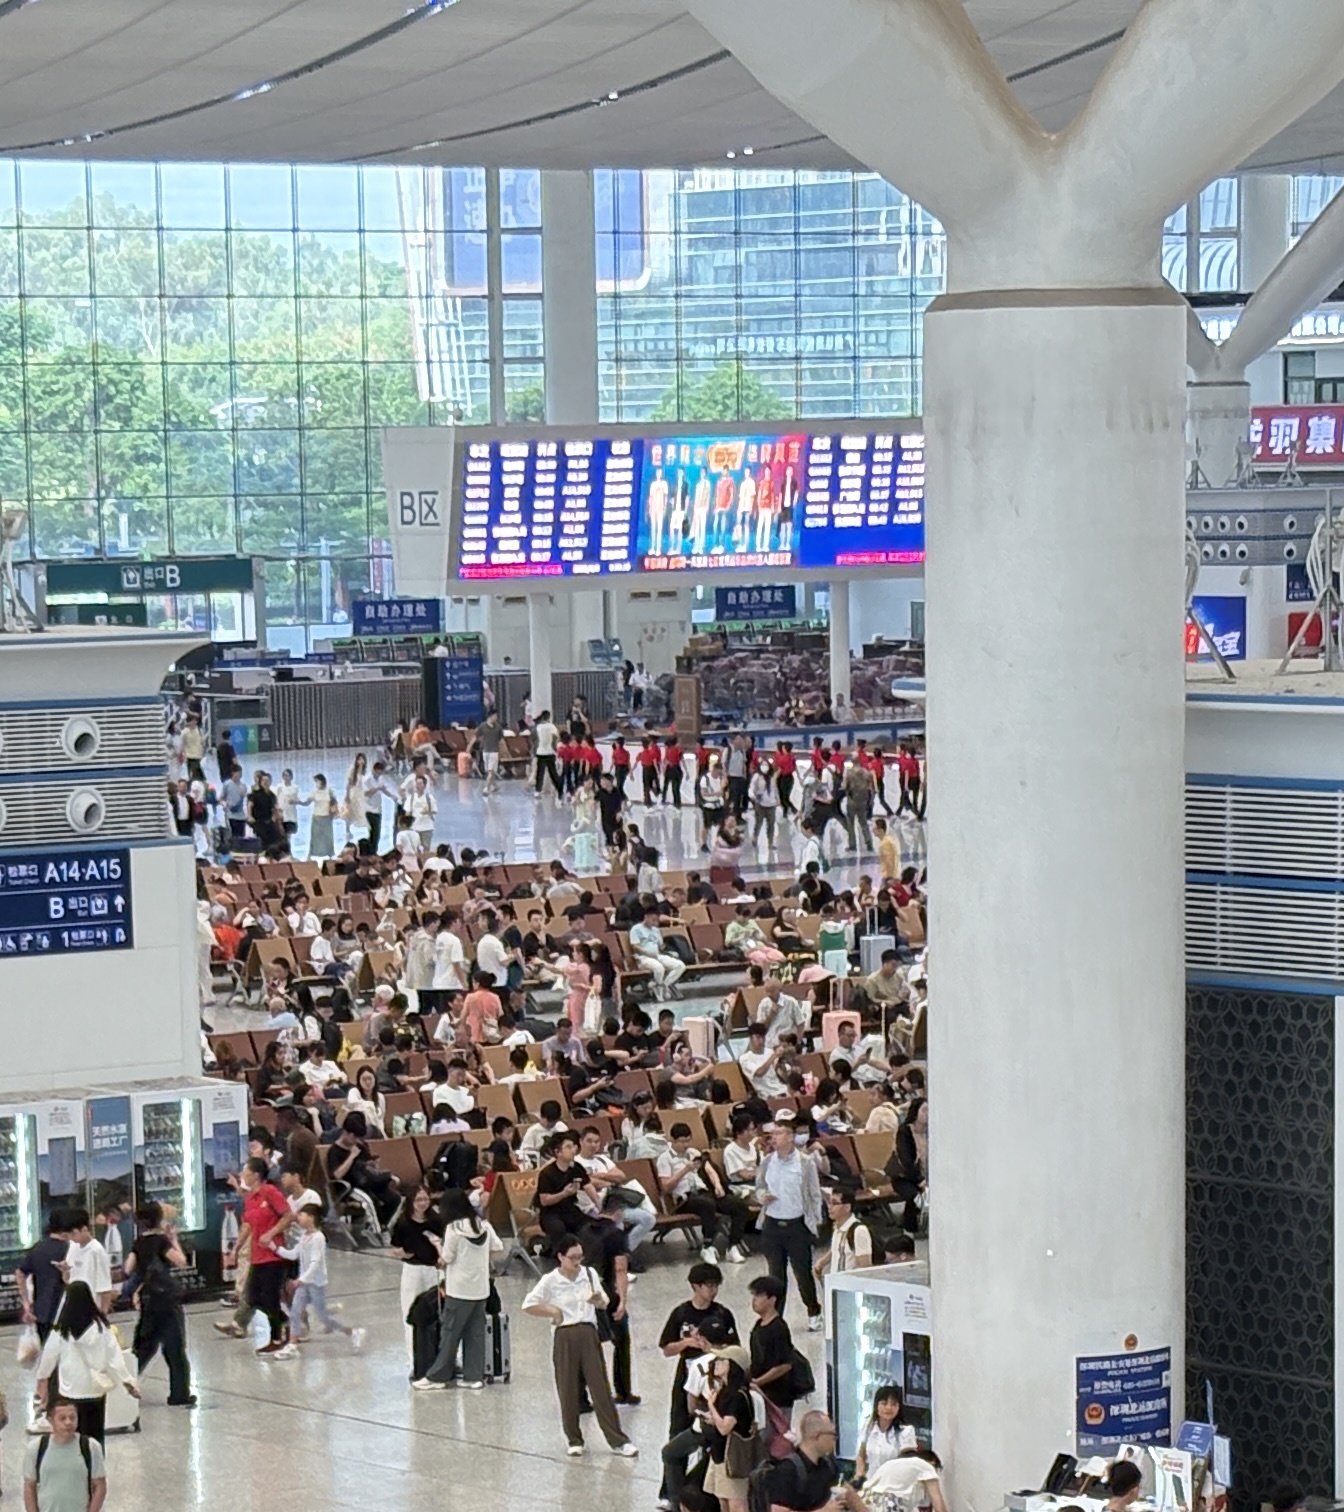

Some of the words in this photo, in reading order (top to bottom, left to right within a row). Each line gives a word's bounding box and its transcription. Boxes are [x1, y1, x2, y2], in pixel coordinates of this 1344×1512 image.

[400, 490, 441, 526] B区
[166, 564, 181, 588] B
[44, 858, 122, 883] A14·A15
[49, 896, 65, 919] B
